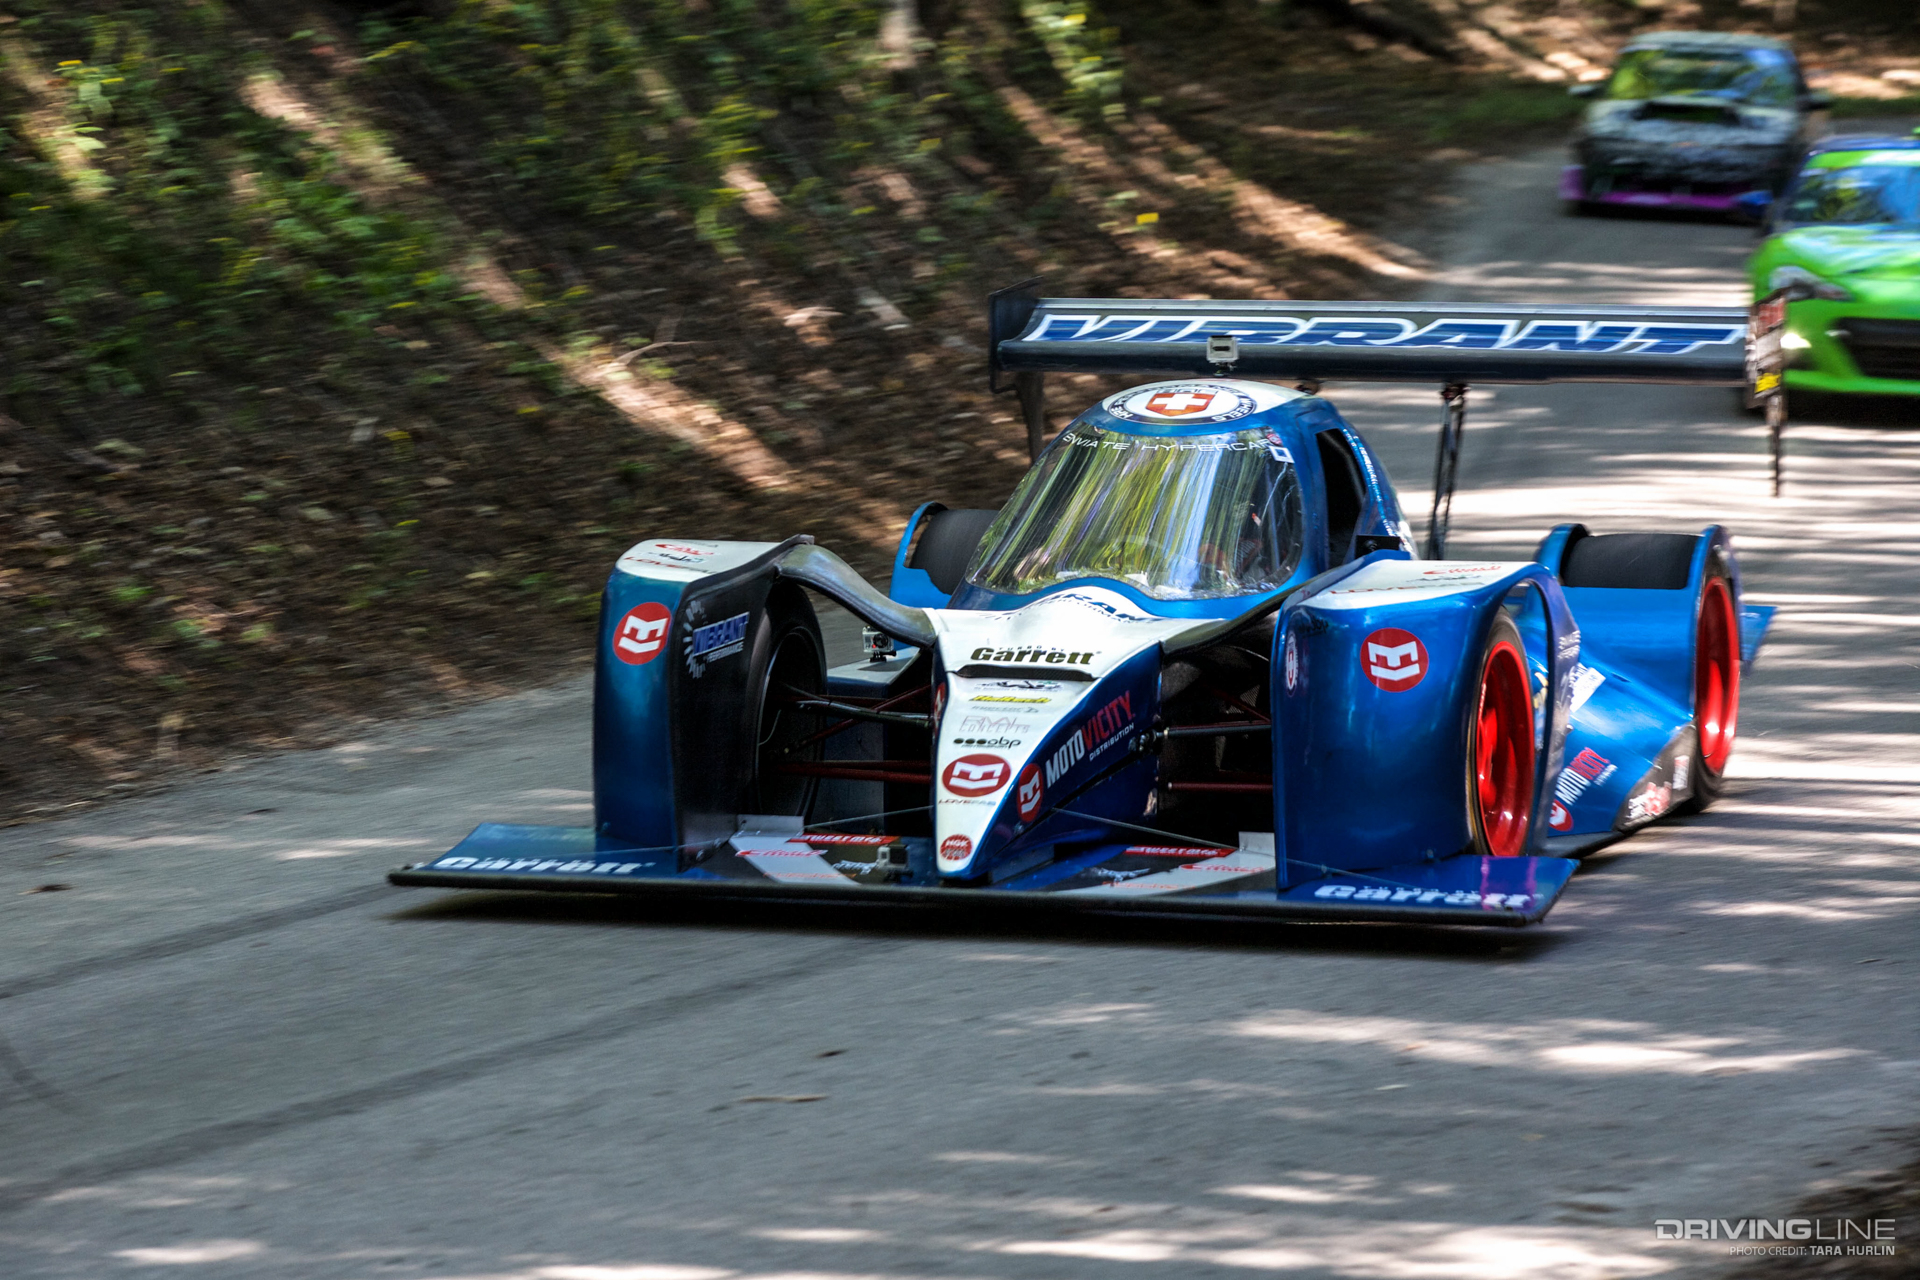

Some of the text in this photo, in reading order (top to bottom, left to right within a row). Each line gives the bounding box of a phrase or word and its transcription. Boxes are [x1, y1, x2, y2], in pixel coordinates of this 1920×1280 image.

[1022, 314, 1748, 355] VIBRANT
[1141, 438, 1275, 452] HYPERCAR
[970, 647, 1095, 665] Garrett
[1045, 690, 1133, 789] MOTOVICITY
[1089, 722, 1134, 762] DISTRIBUTION
